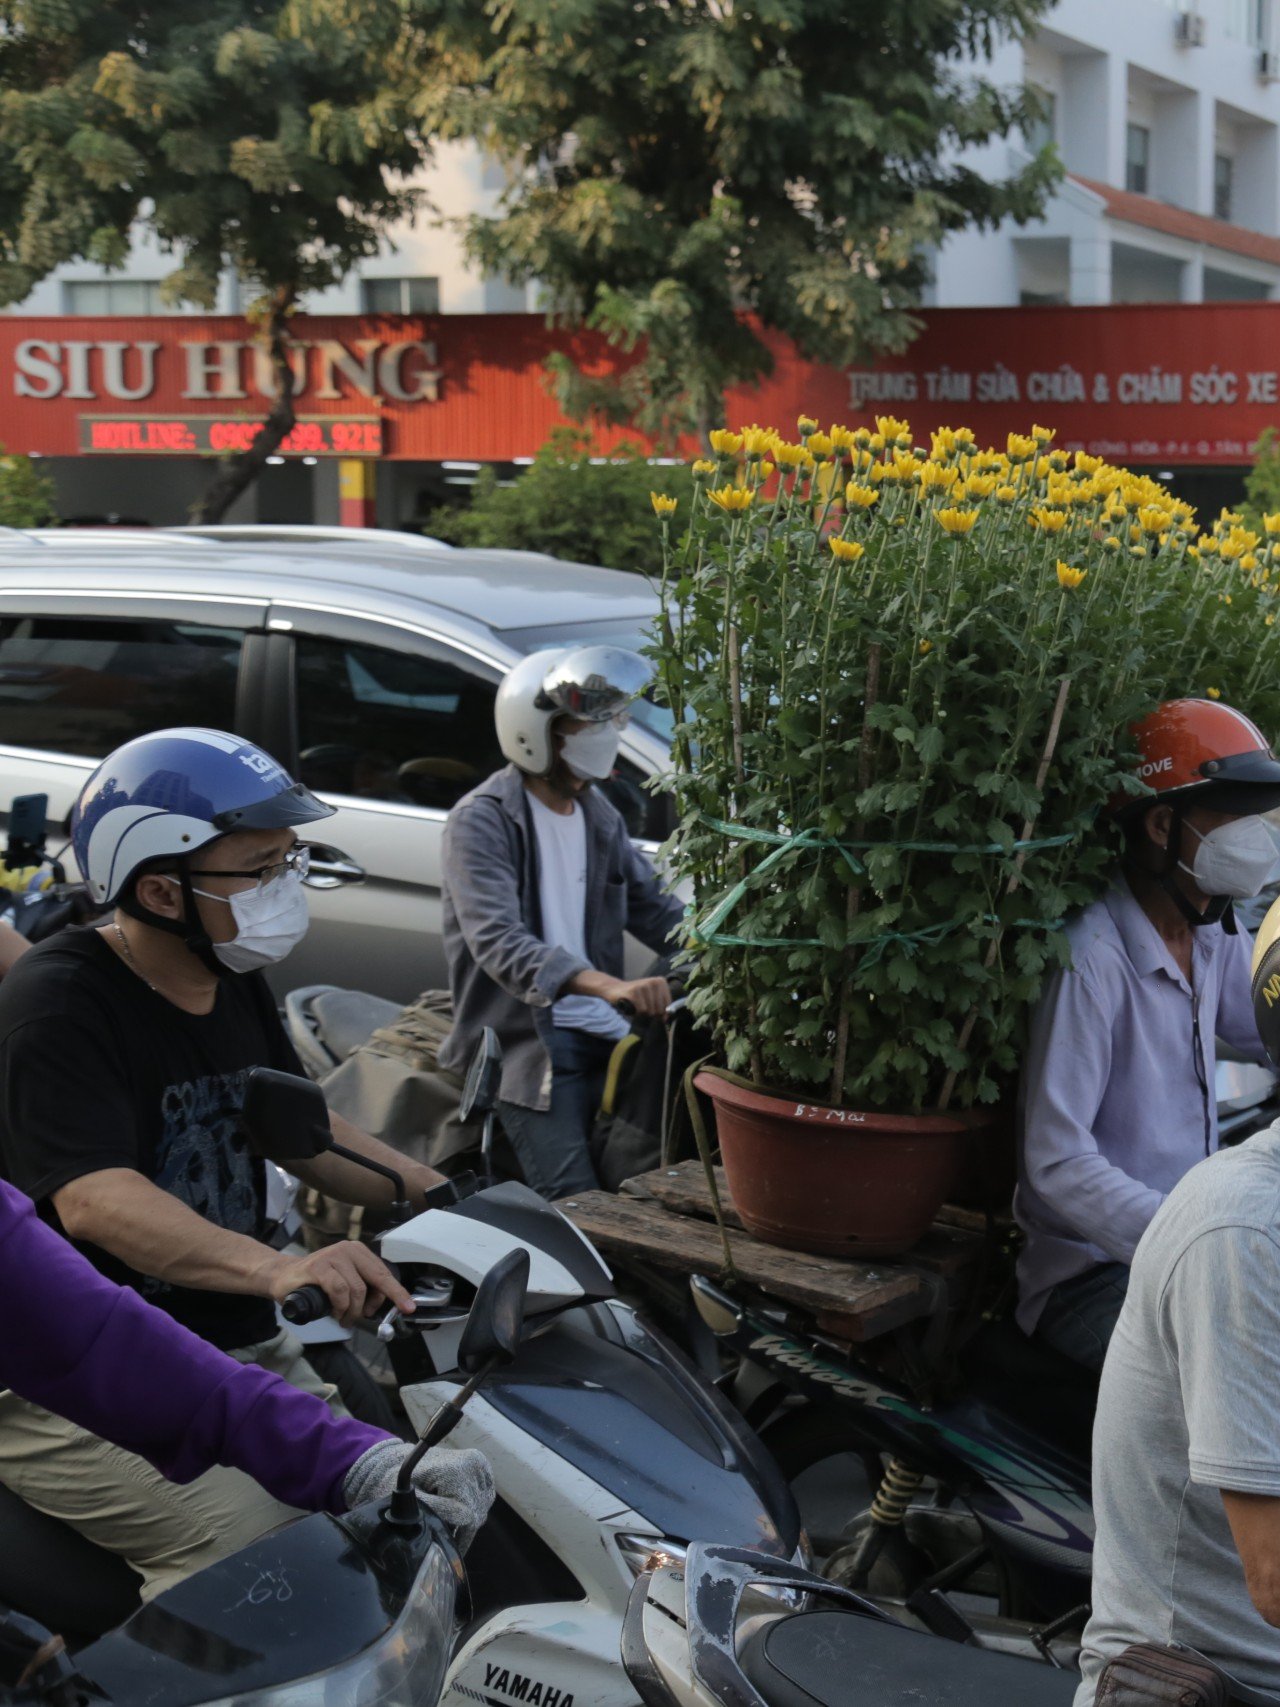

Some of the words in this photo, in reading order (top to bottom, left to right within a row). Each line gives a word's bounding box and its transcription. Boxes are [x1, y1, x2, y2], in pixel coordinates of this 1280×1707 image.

[14, 339, 159, 400] SIU
[848, 372, 917, 402] TRUNG
[925, 365, 970, 402] TÂM
[1093, 373, 1110, 403] &
[1190, 364, 1237, 404] SÓC
[1246, 372, 1278, 403] XE
[92, 422, 195, 450] HOTLINE:
[483, 1662, 575, 1707] YAMAHA
